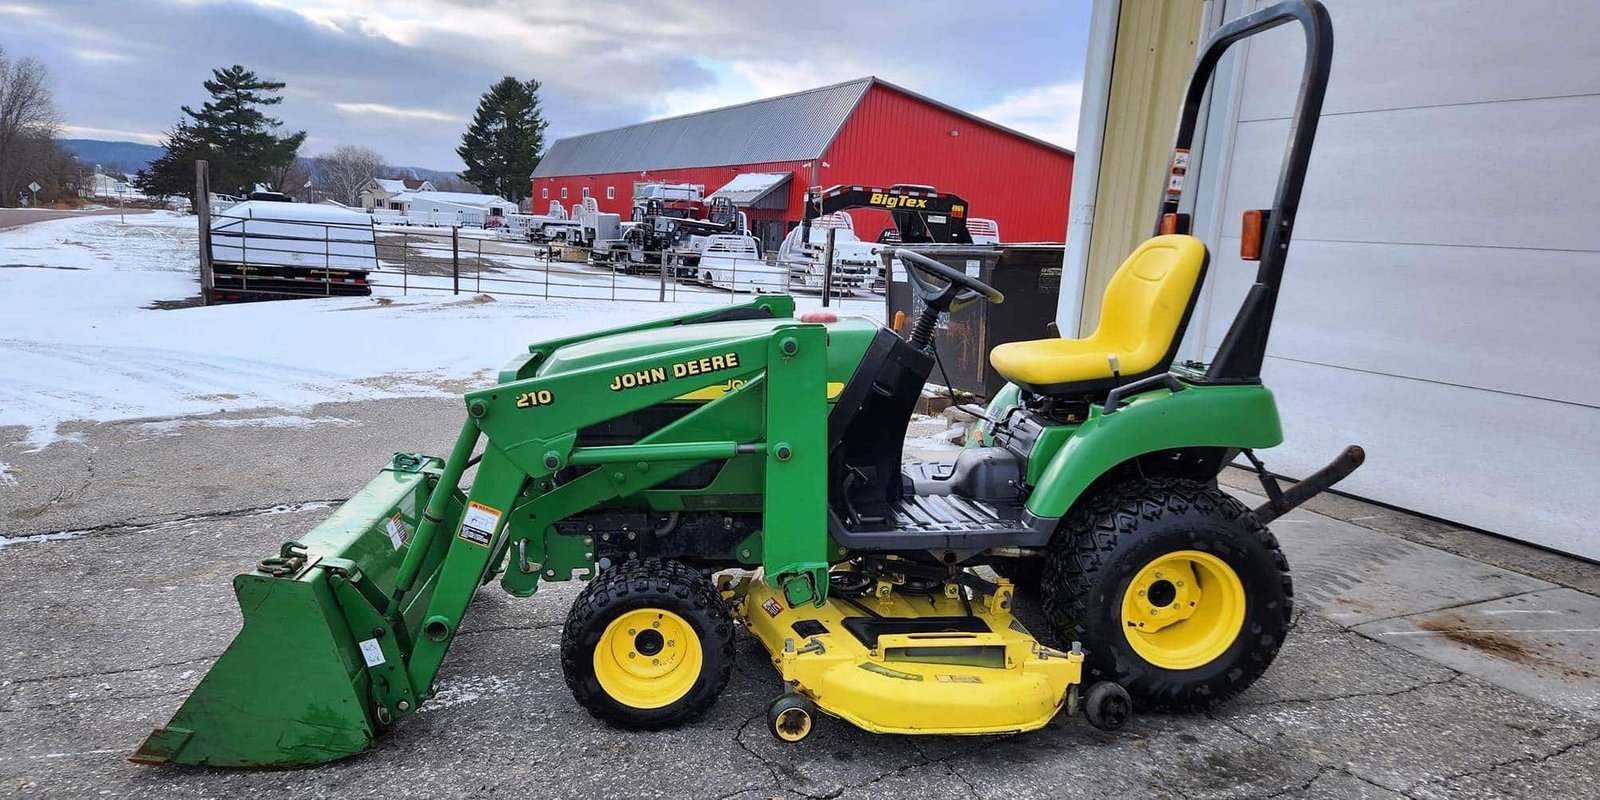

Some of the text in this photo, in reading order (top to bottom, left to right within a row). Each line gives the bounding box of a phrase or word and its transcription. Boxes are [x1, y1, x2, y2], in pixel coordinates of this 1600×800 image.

[870, 193, 928, 208] BigTex
[609, 352, 740, 391] JOHN DEERE
[723, 379, 748, 391] JO
[515, 390, 553, 408] 210
